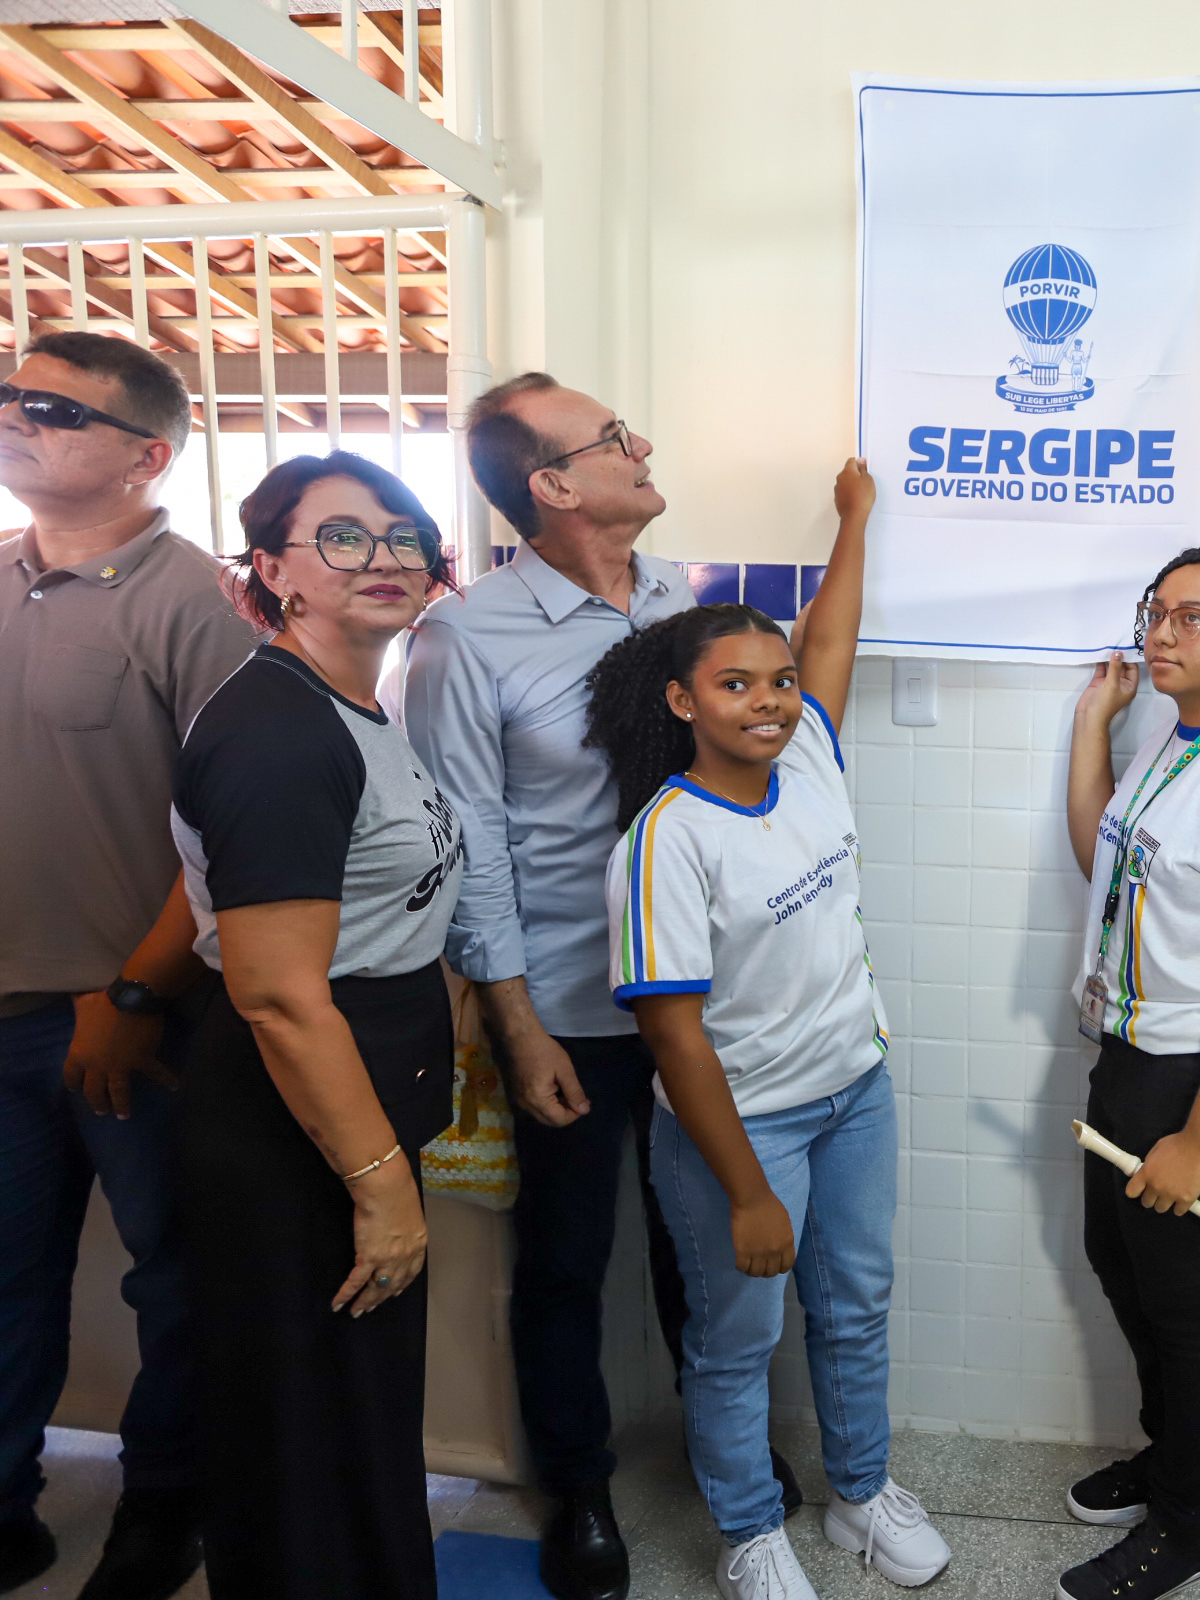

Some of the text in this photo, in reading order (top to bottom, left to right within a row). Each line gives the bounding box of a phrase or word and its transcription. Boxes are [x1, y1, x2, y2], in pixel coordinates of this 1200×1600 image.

[1019, 282, 1080, 299] PORVIR
[1005, 392, 1084, 405] SUB LEGE LIBERTAS
[906, 425, 1175, 478] SERGIPE
[904, 477, 1174, 504] GOVERNO DO ESTADO
[767, 882, 801, 909] Centro
[775, 901, 803, 925] John
